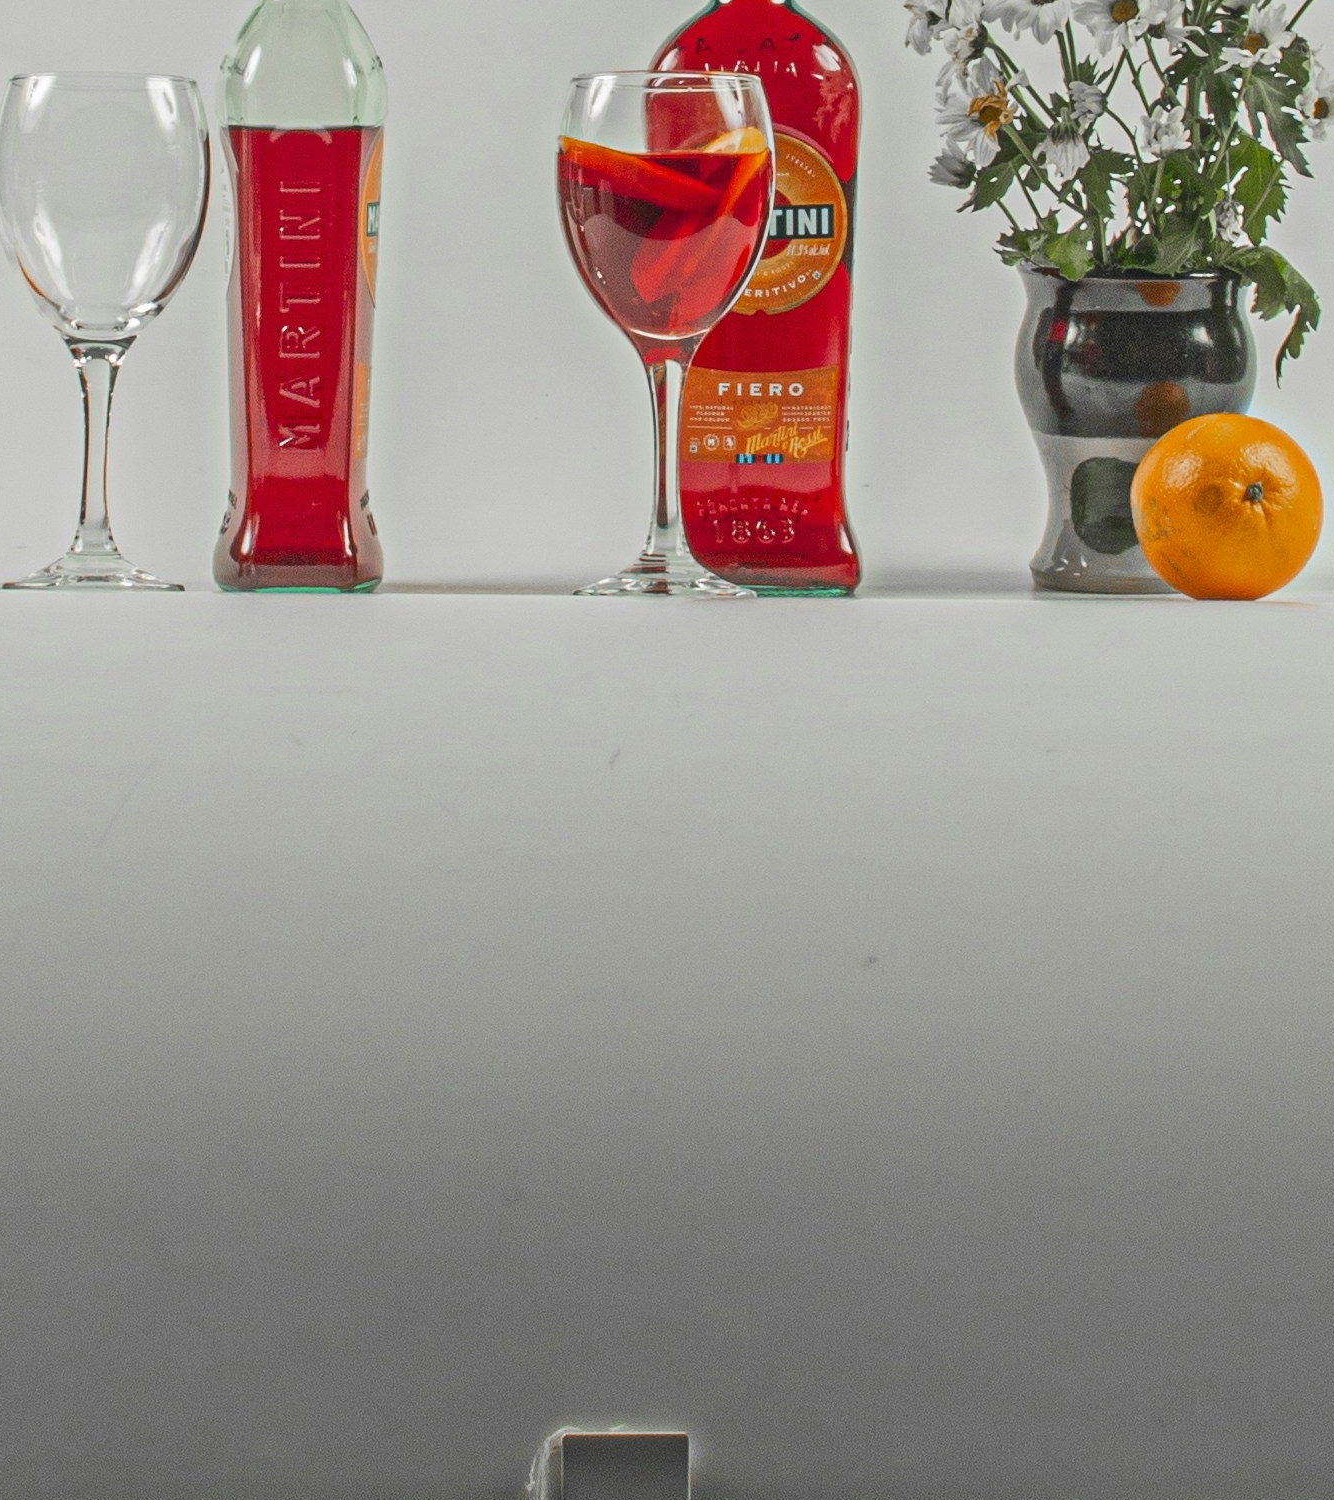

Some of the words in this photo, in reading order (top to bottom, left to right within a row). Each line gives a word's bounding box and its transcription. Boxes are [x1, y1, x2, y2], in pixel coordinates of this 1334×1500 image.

[768, 207, 829, 236] TINI
[743, 274, 806, 298] ERITIVO
[279, 180, 321, 448] MARTINI
[718, 382, 805, 396] FIERO
[745, 421, 799, 455] Martini
[713, 518, 795, 544] 1863
